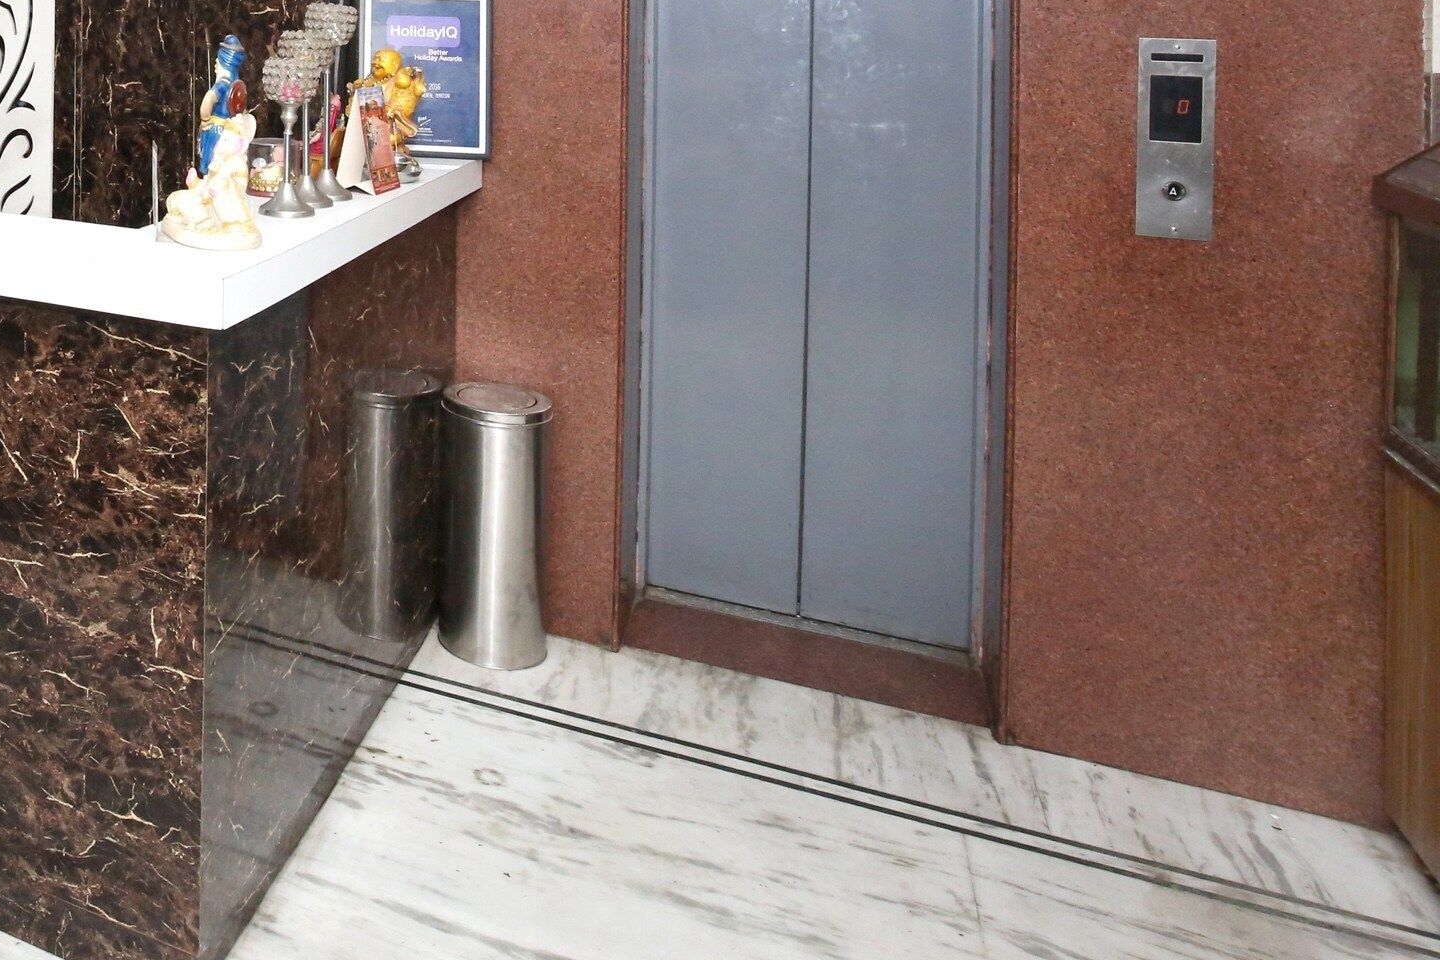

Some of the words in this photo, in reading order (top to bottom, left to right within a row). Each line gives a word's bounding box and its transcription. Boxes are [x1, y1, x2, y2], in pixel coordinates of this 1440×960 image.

[390, 24, 458, 41] HolidayIQ
[428, 48, 448, 56] Better
[414, 54, 438, 62] Holiday
